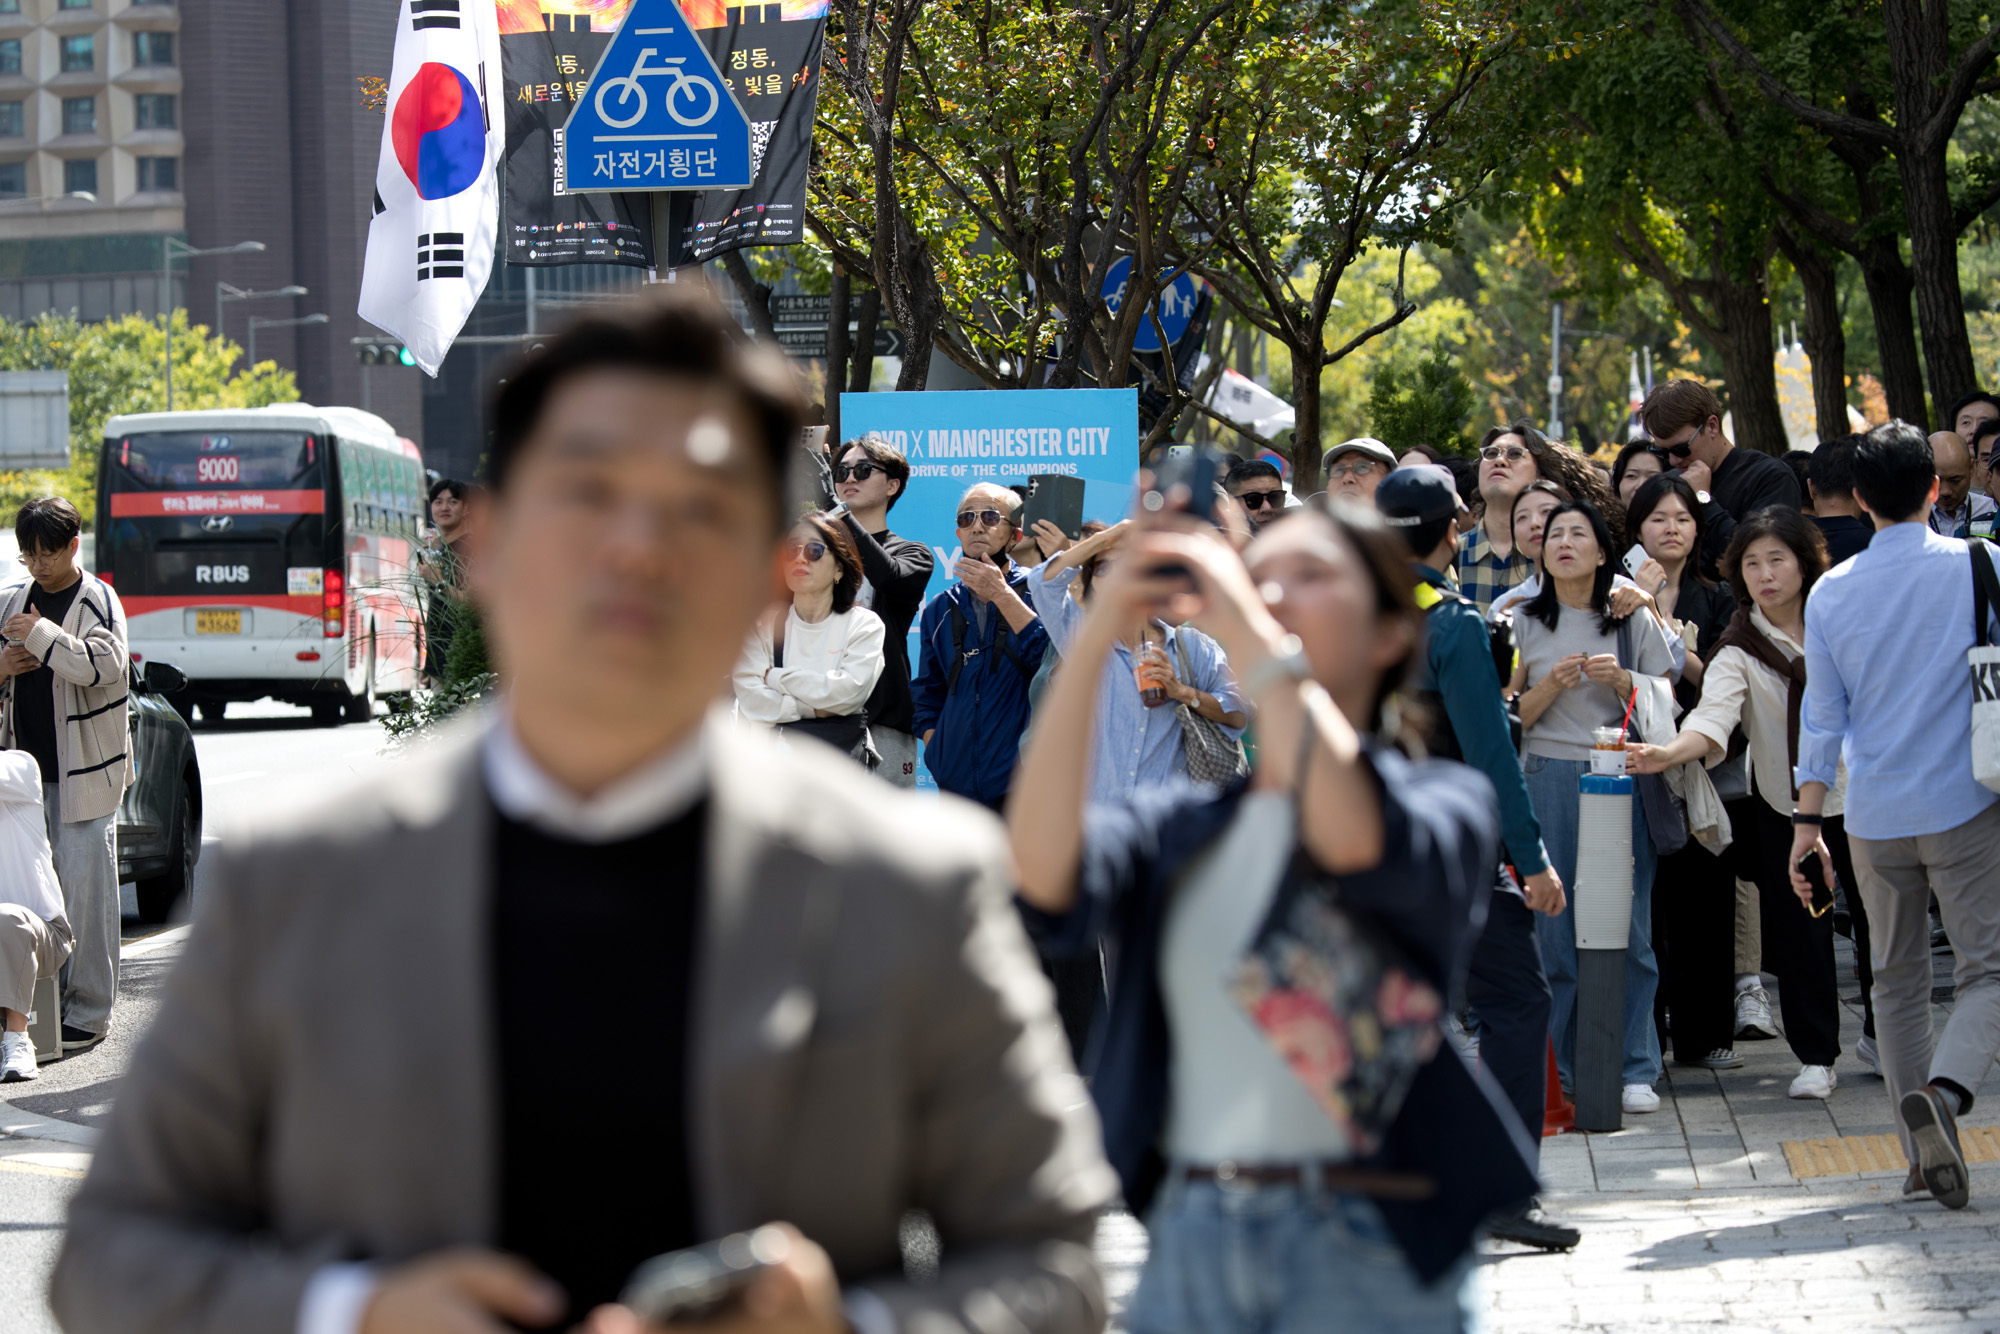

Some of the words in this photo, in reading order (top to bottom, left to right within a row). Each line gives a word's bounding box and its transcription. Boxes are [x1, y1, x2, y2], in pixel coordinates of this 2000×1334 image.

[731, 48, 776, 70] 정동,
[518, 82, 563, 104] 새로운
[745, 74, 783, 96] 빛을
[593, 148, 718, 180] 자전거횡단
[928, 428, 1061, 458] MANCHESTER
[1067, 427, 1110, 456] CITY
[198, 457, 238, 481] 9000
[910, 464, 948, 478] DRIVE
[951, 464, 967, 477] OF
[971, 463, 997, 477] THE
[1000, 462, 1078, 476] CHAMPIONS
[902, 761, 914, 776] 93
